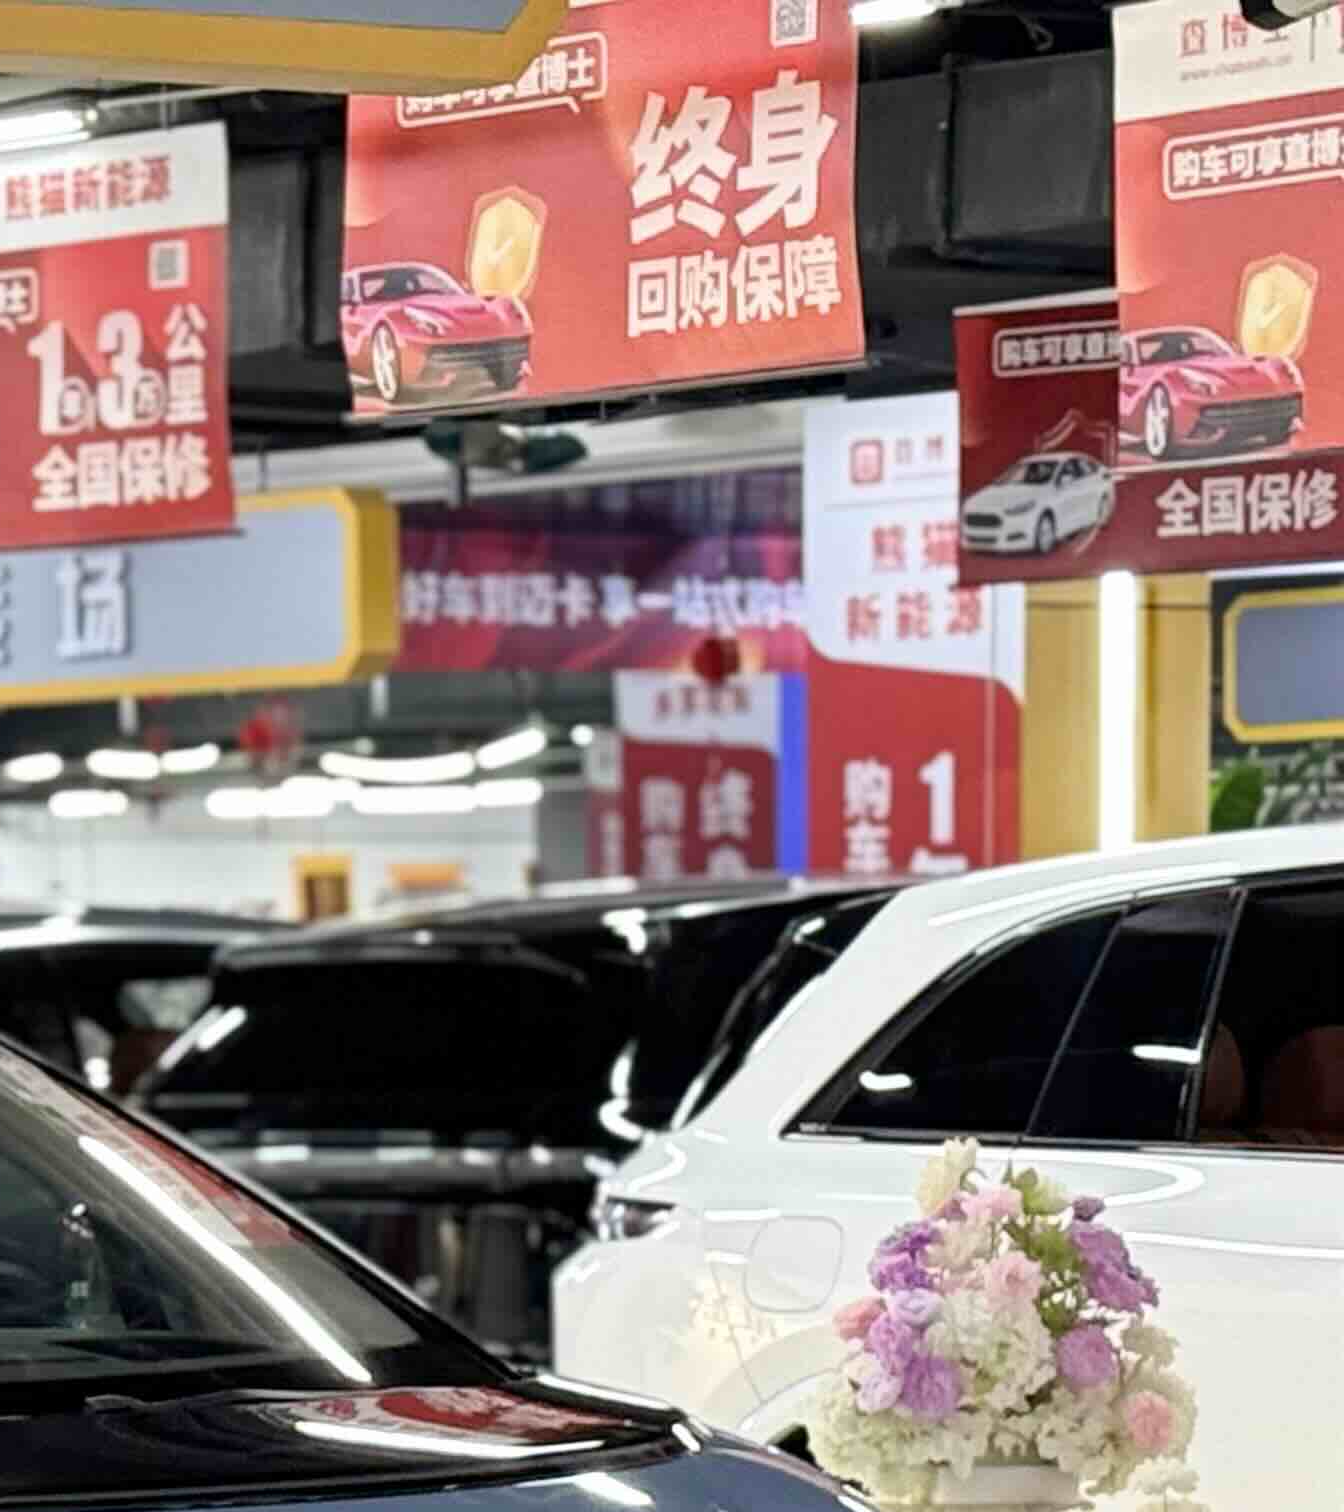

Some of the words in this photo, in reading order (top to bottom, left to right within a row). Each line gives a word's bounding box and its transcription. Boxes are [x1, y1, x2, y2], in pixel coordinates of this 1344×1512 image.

[628, 68, 840, 245] 终身
[1172, 126, 1344, 188] 购车可享查博
[627, 234, 842, 338] 回购保障
[31, 432, 213, 513] 全国保修
[1155, 468, 1339, 538] 全国保修
